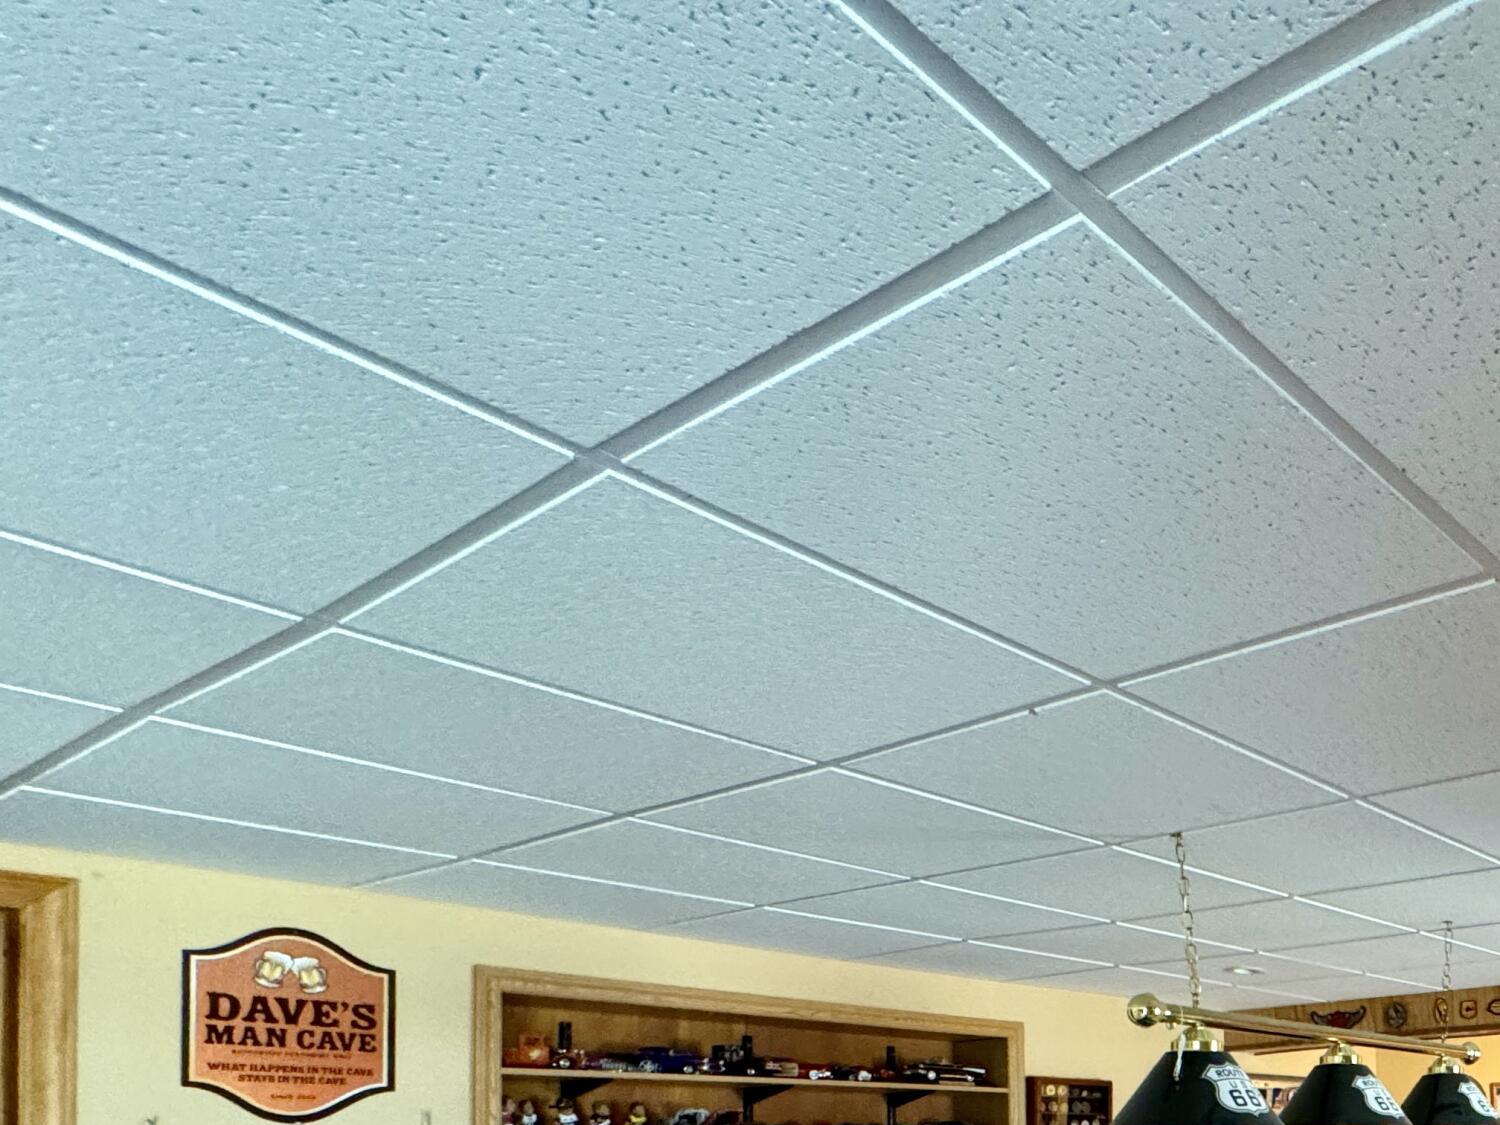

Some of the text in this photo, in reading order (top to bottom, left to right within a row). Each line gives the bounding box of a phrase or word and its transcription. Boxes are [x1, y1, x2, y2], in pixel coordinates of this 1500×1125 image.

[205, 991, 378, 1030] DAVE'S
[204, 1024, 378, 1053] MAN CAVE
[206, 1062, 374, 1078] WHAT HAPPENS IN THE CAVE
[237, 1073, 347, 1086] STAYS IN THE CAVE
[1228, 1090, 1262, 1107] 66
